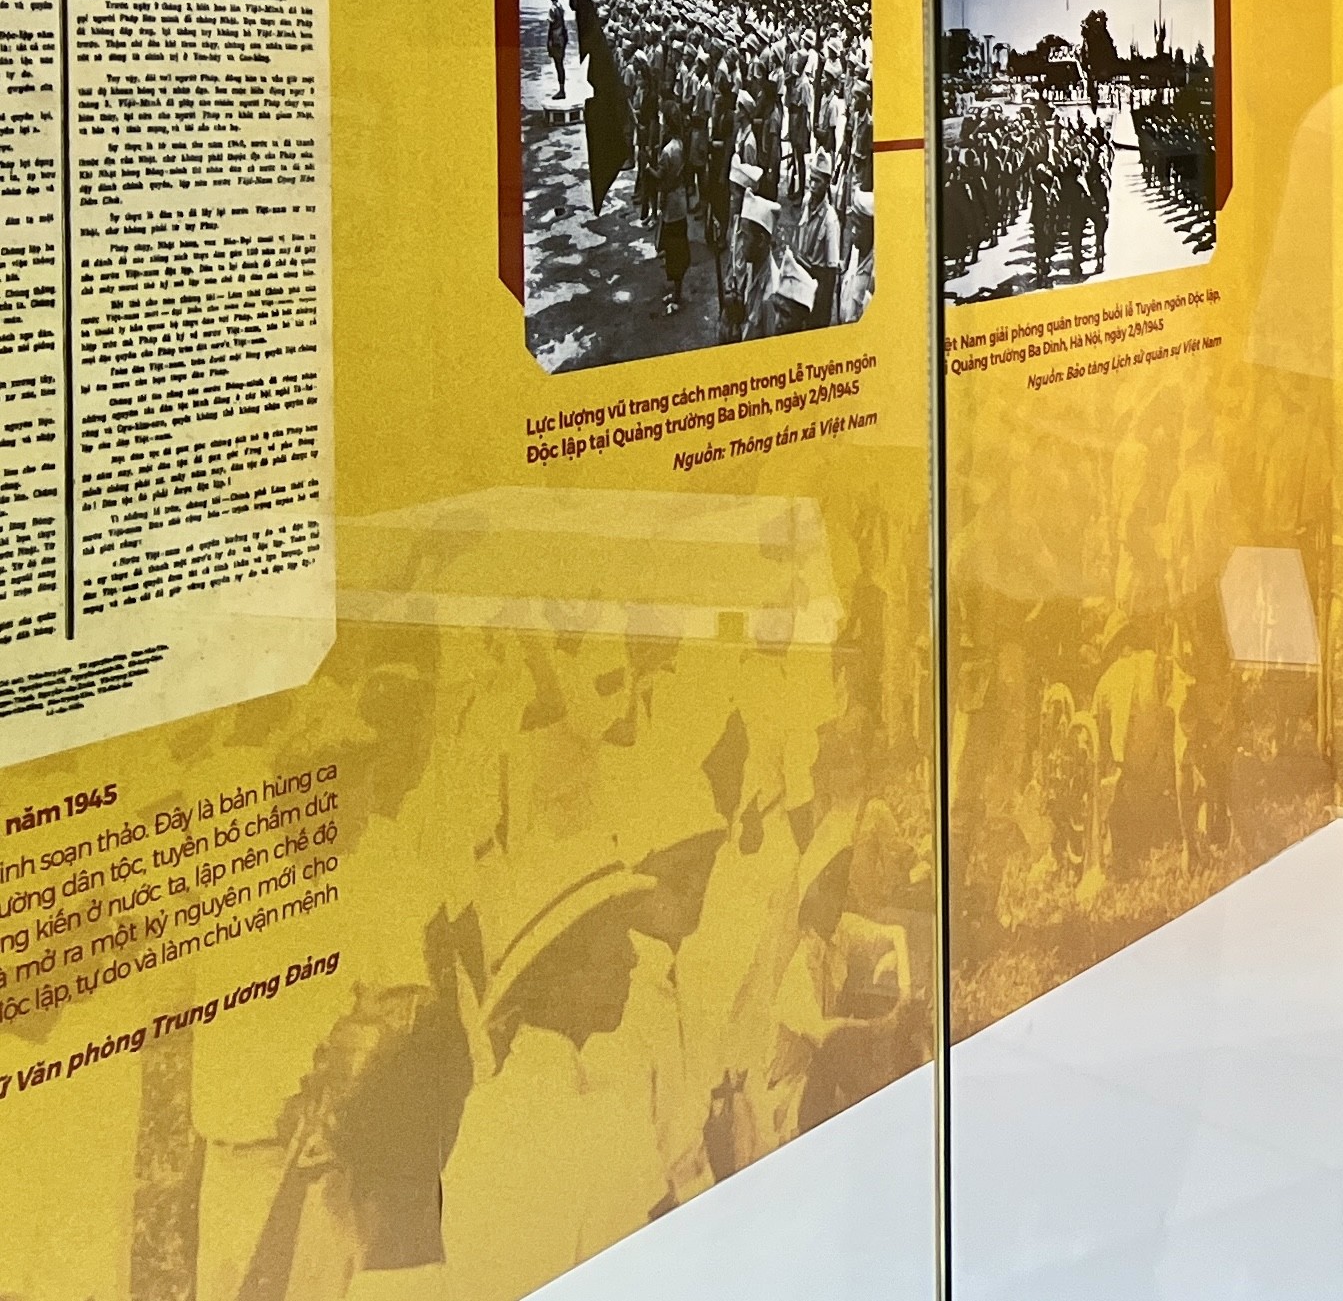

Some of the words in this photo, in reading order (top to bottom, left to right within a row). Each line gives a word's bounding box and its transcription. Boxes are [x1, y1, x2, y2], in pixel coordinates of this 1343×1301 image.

[526, 417, 555, 439] Lực
[559, 409, 605, 431] lượng
[608, 399, 626, 420] vũ
[629, 397, 669, 416] trang
[672, 383, 705, 407] cách
[708, 382, 747, 402] mạng
[750, 374, 786, 392] trong
[789, 361, 804, 384] Lễ
[806, 359, 843, 383] Tuyên
[846, 353, 876, 376] ngôn
[673, 442, 726, 473] Nguồn:
[729, 435, 772, 458] Thông
[775, 424, 797, 447] tấn
[800, 421, 817, 441] xã
[820, 417, 845, 439] Việt
[848, 413, 878, 430] Nam
[5, 804, 61, 835] năm
[64, 781, 118, 817] 1945
[41, 845, 92, 874] soạn
[97, 824, 149, 856] thảo.
[154, 809, 193, 837] Đây
[198, 798, 214, 824] là
[219, 788, 257, 817] bản
[263, 774, 312, 802] hùng
[316, 765, 337, 785] ca
[36, 905, 82, 941] kiến
[86, 898, 101, 924] ở
[108, 882, 162, 916] nước
[168, 875, 190, 896] ta,
[195, 860, 226, 890] lập
[231, 845, 269, 874] nên
[273, 822, 309, 860] chế
[313, 817, 338, 848] độ
[17, 1059, 61, 1091] Văn
[66, 1027, 146, 1078] phòng
[152, 998, 219, 1038] Trung
[224, 974, 280, 1009] ương
[285, 950, 340, 985] Đảng
